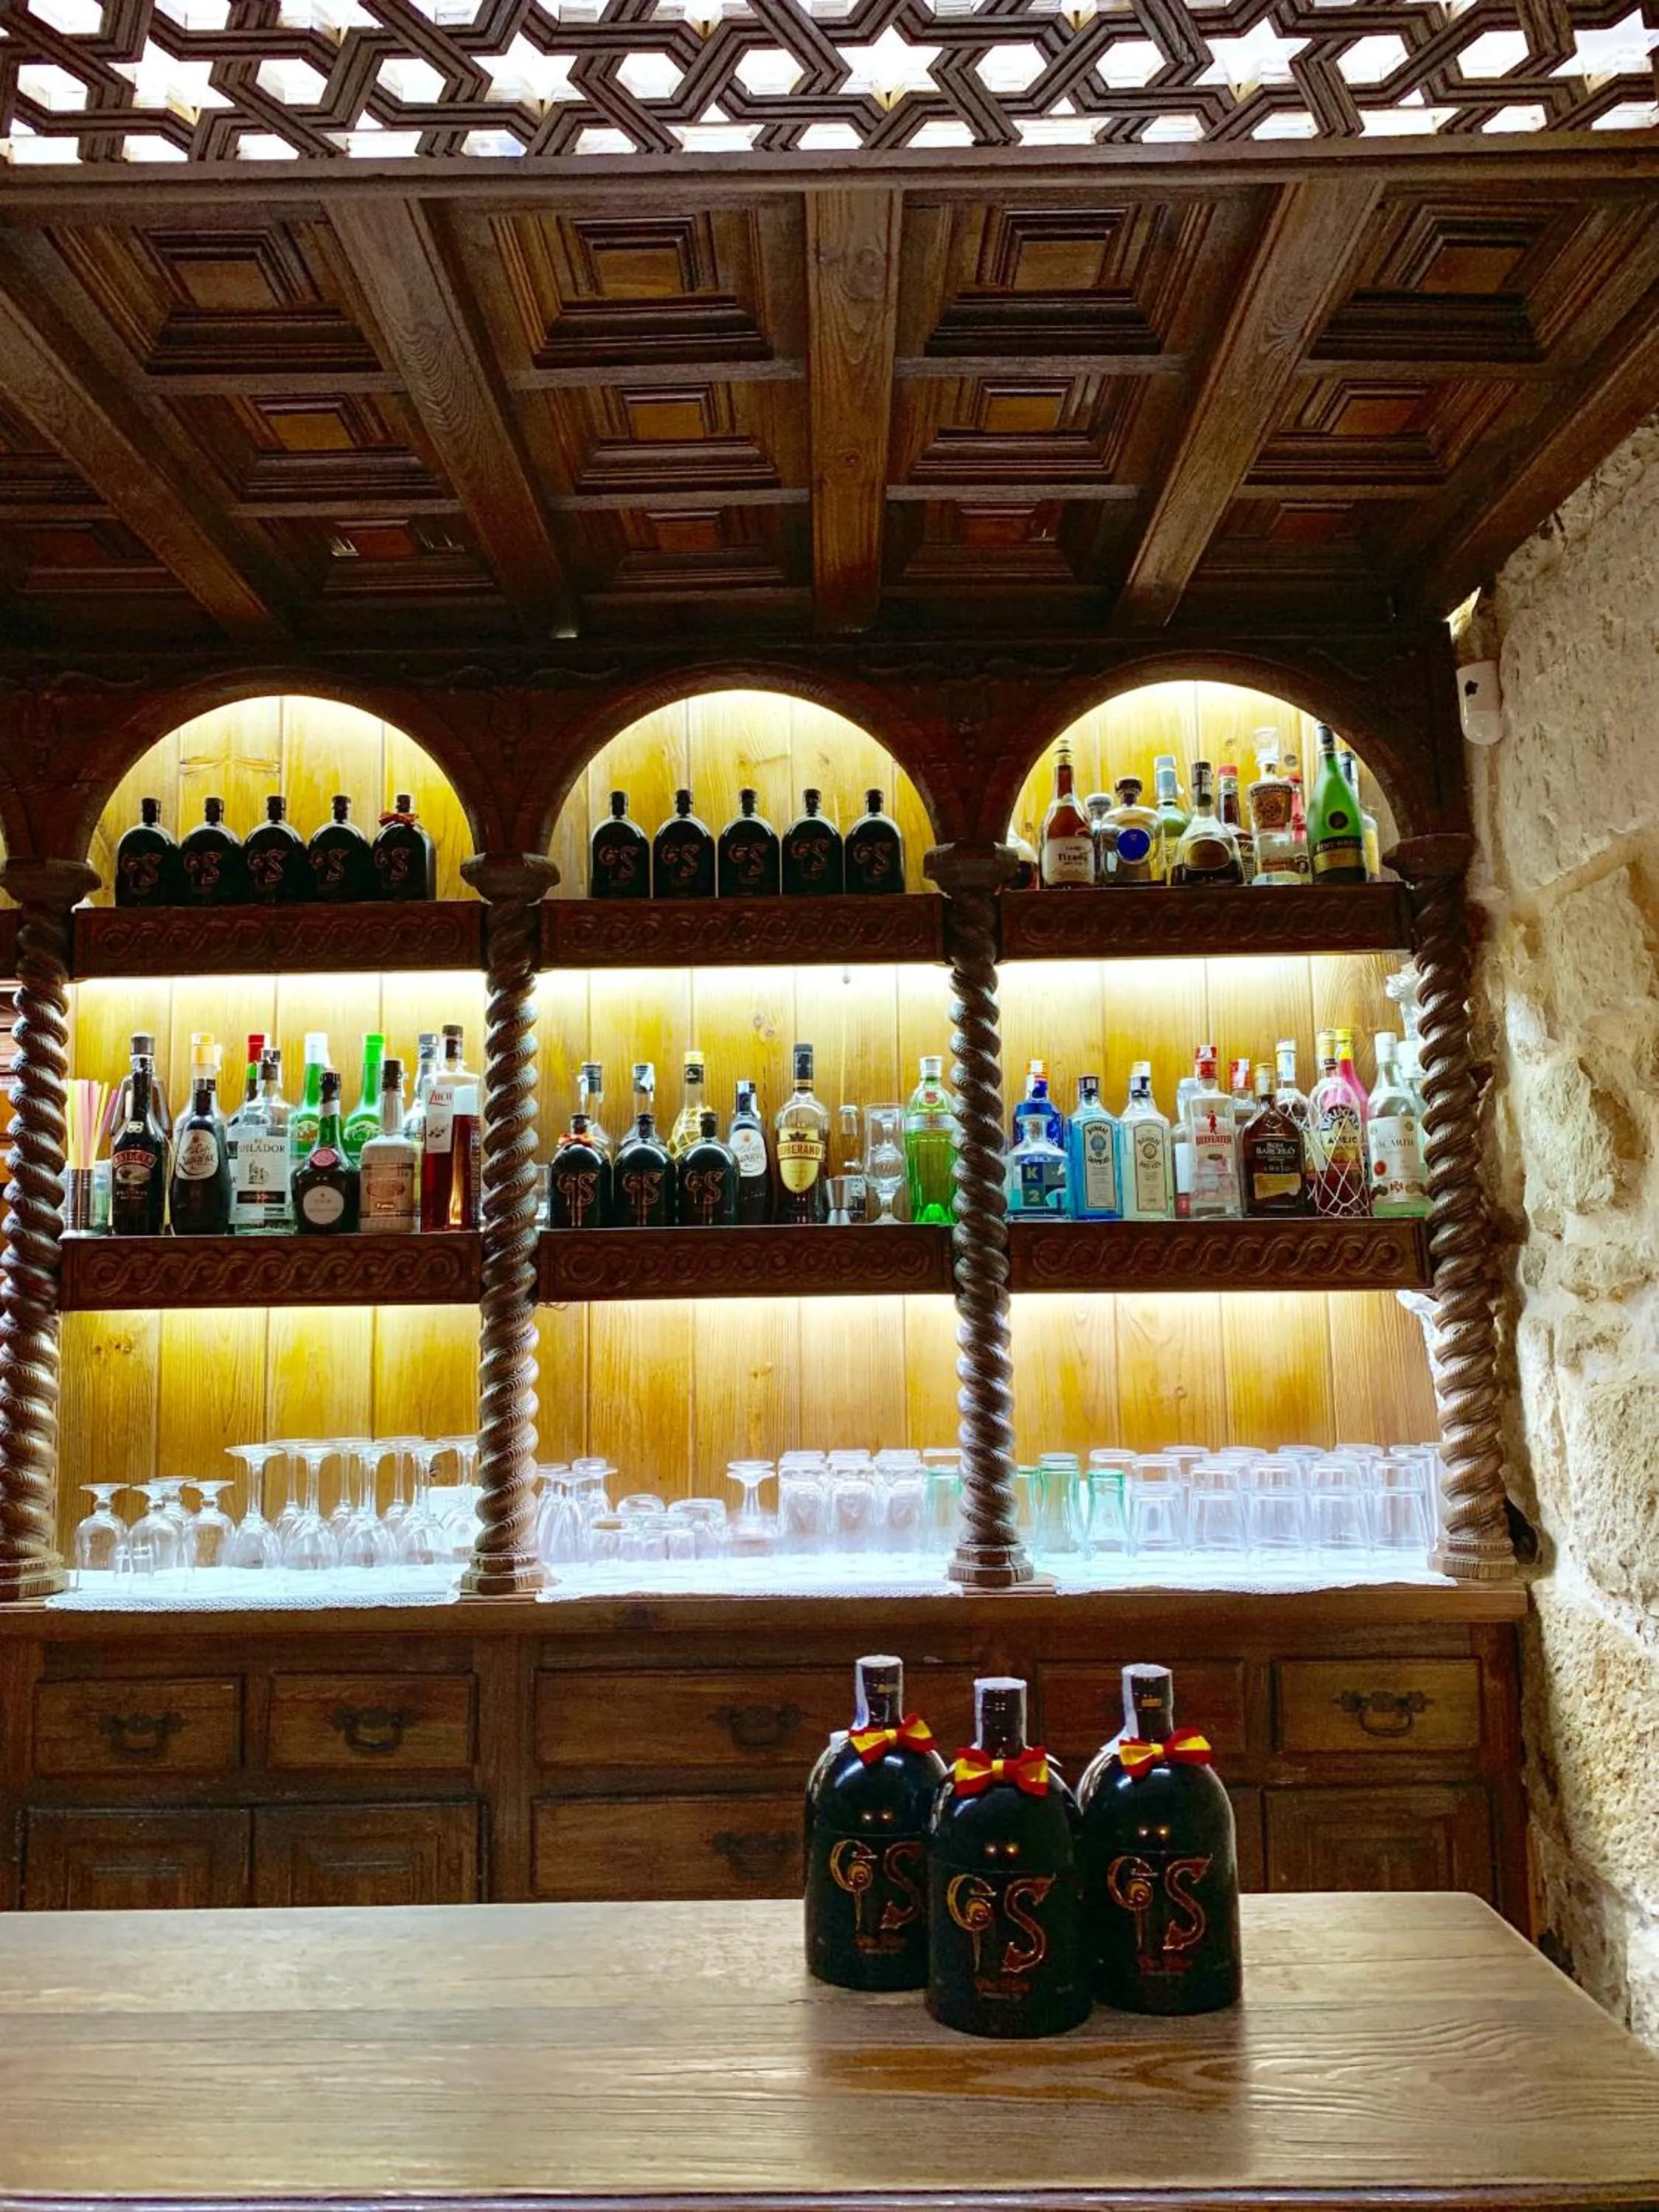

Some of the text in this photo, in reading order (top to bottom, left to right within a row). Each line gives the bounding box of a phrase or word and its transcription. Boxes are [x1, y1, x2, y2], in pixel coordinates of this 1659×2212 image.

[1195, 1134, 1232, 1145] BEEFEATER
[1026, 1166, 1038, 1179] K
[1027, 1189, 1040, 1203] 2
